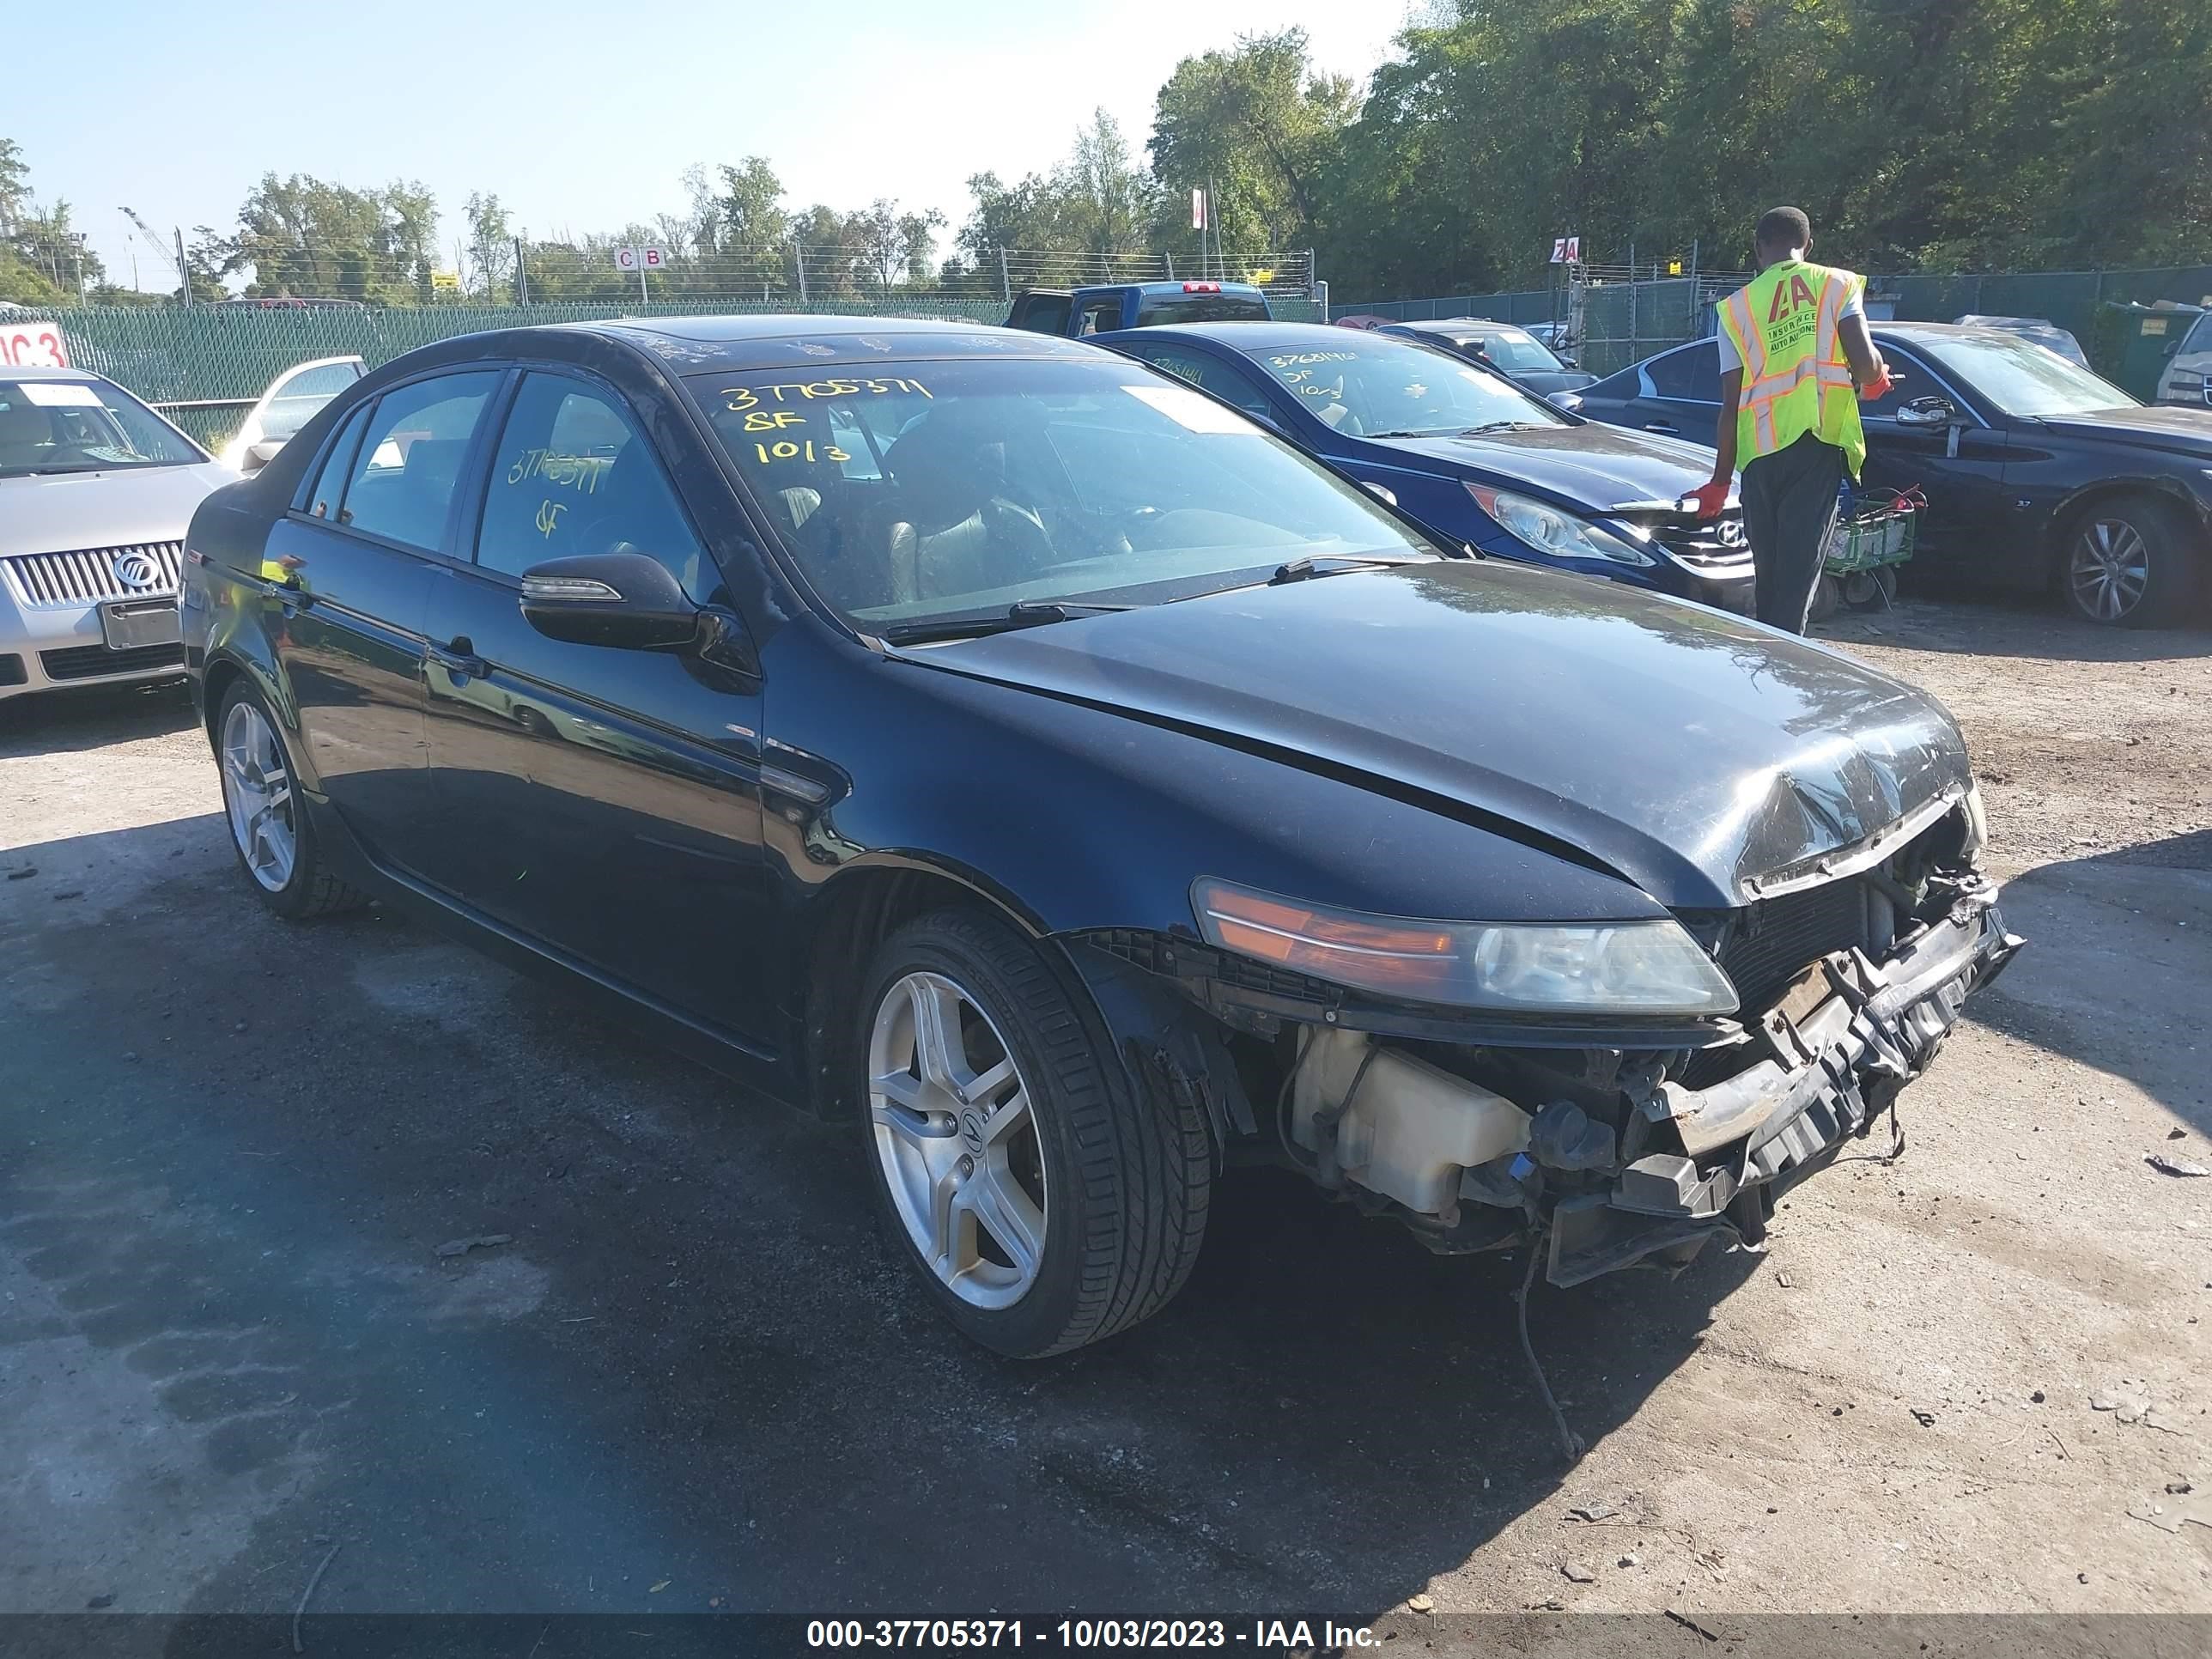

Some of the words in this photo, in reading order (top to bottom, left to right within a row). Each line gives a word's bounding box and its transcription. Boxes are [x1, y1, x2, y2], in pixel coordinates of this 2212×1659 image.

[620, 252, 633, 266] C
[647, 250, 659, 264] B
[1768, 313, 1816, 340] INSURNCE
[1771, 338, 1788, 353] AUTO
[720, 379, 934, 410] 37705371
[744, 412, 807, 431] SF
